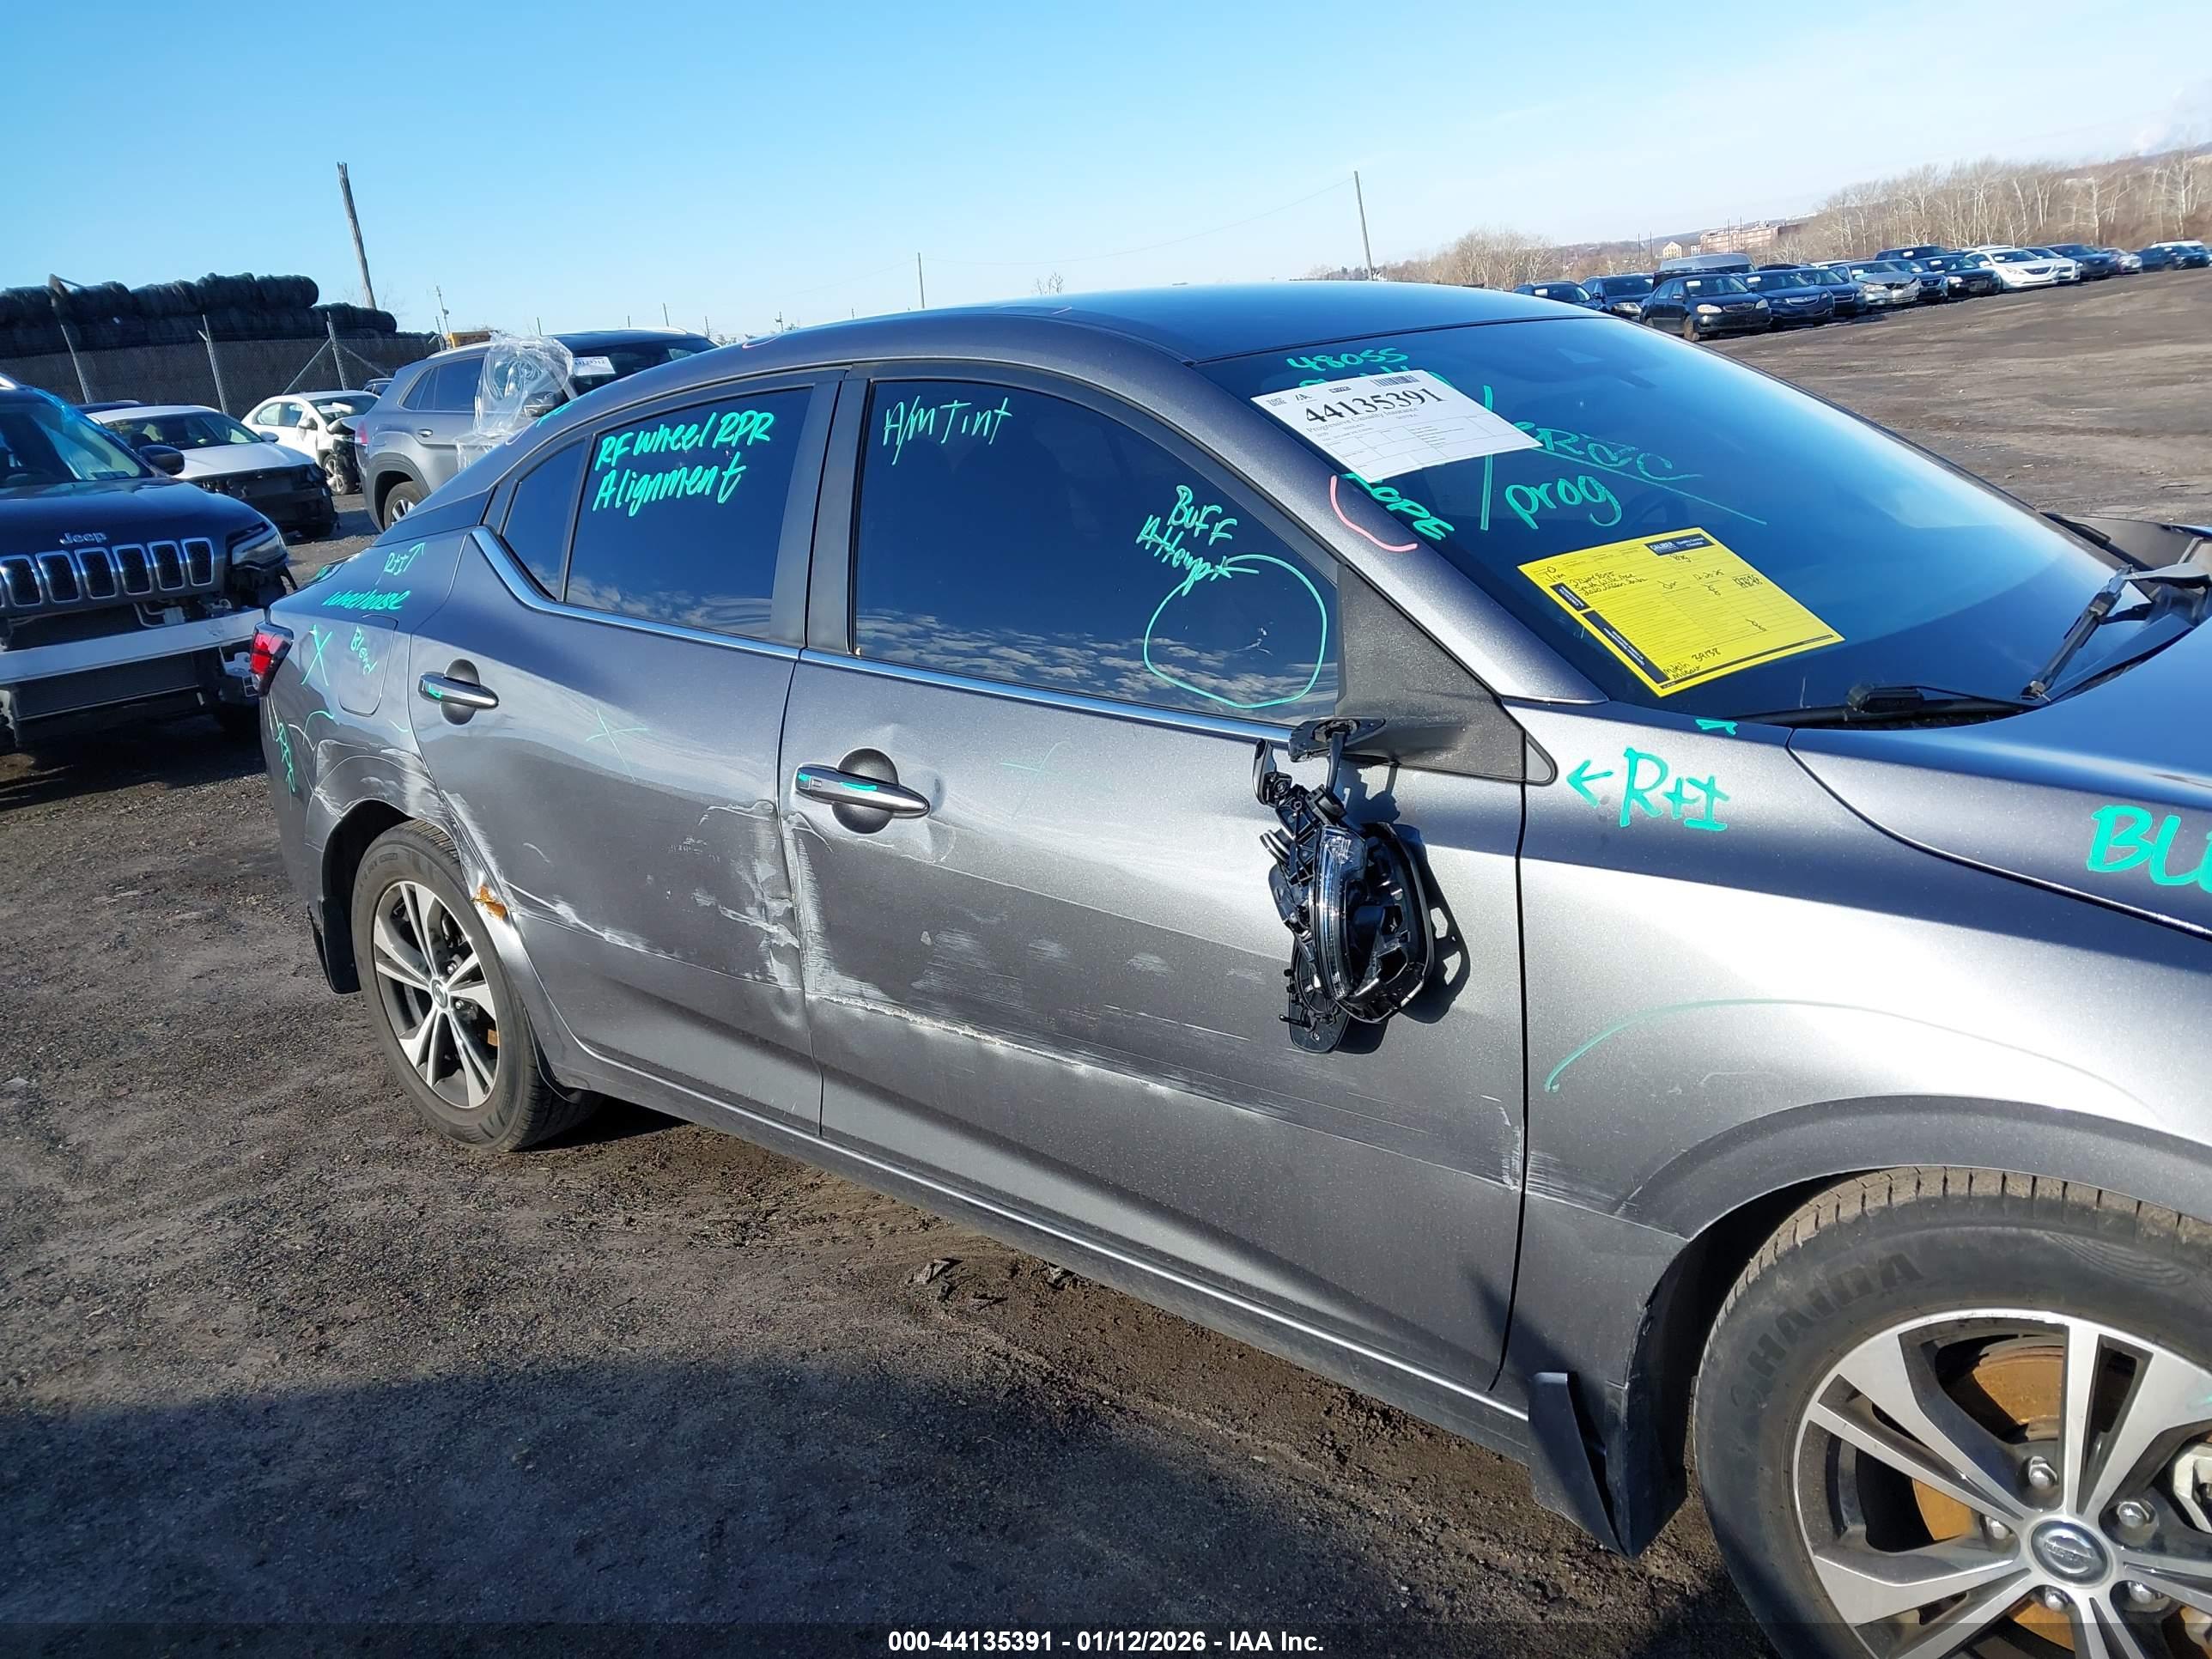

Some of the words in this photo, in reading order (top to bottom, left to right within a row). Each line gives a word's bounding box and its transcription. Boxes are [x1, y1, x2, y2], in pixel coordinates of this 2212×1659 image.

[1305, 386, 1448, 423] 44135391
[592, 451, 747, 517] Alignment
[58, 532, 107, 545] Jeep
